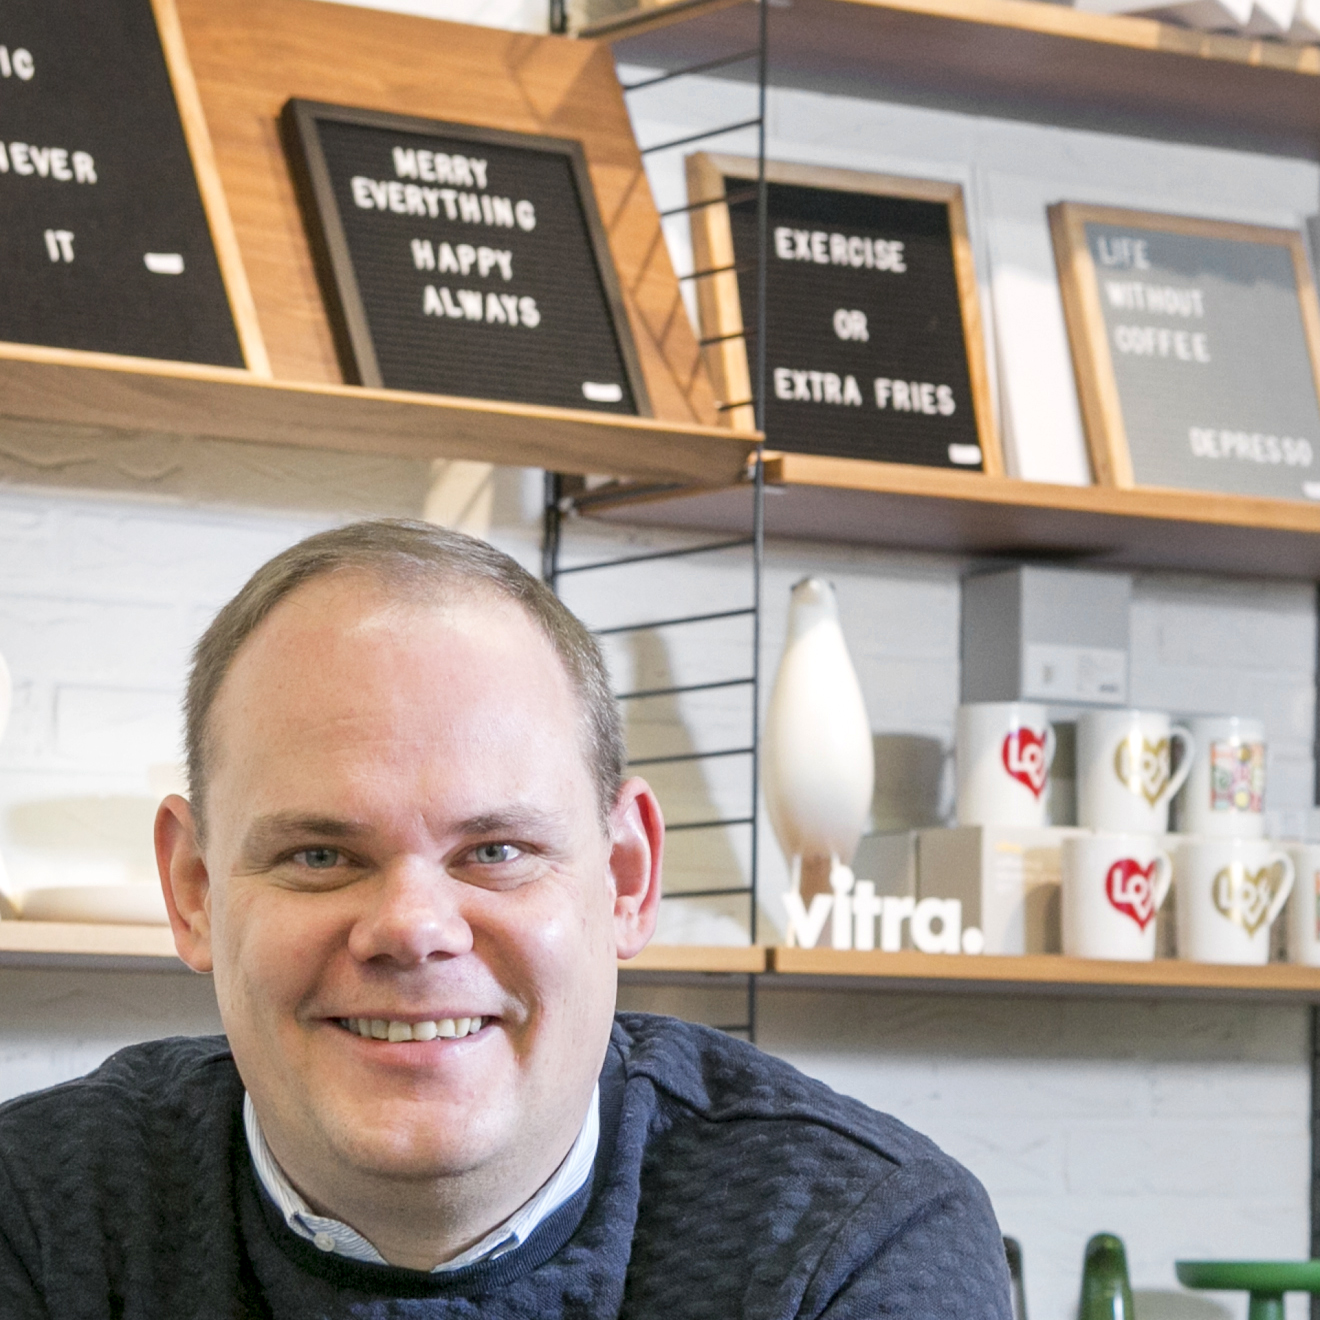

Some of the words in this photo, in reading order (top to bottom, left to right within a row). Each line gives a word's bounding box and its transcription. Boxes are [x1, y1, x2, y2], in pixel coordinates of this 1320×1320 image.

[391, 146, 488, 189] MERRY
[350, 176, 537, 231] EVERYTHING
[43, 229, 75, 263] IT
[410, 239, 514, 281] HAPPY
[774, 226, 908, 273] EXERCISE
[1096, 235, 1152, 270] LIFE
[423, 284, 541, 328] ALWAYS
[1104, 281, 1206, 318] WITHOUT
[832, 308, 870, 342] OR
[1113, 324, 1212, 363] COFFEE
[773, 367, 863, 407] EXTRA
[874, 377, 957, 416] FRIES
[1187, 426, 1314, 468] DEPRESSO
[782, 864, 985, 955] vitra.
